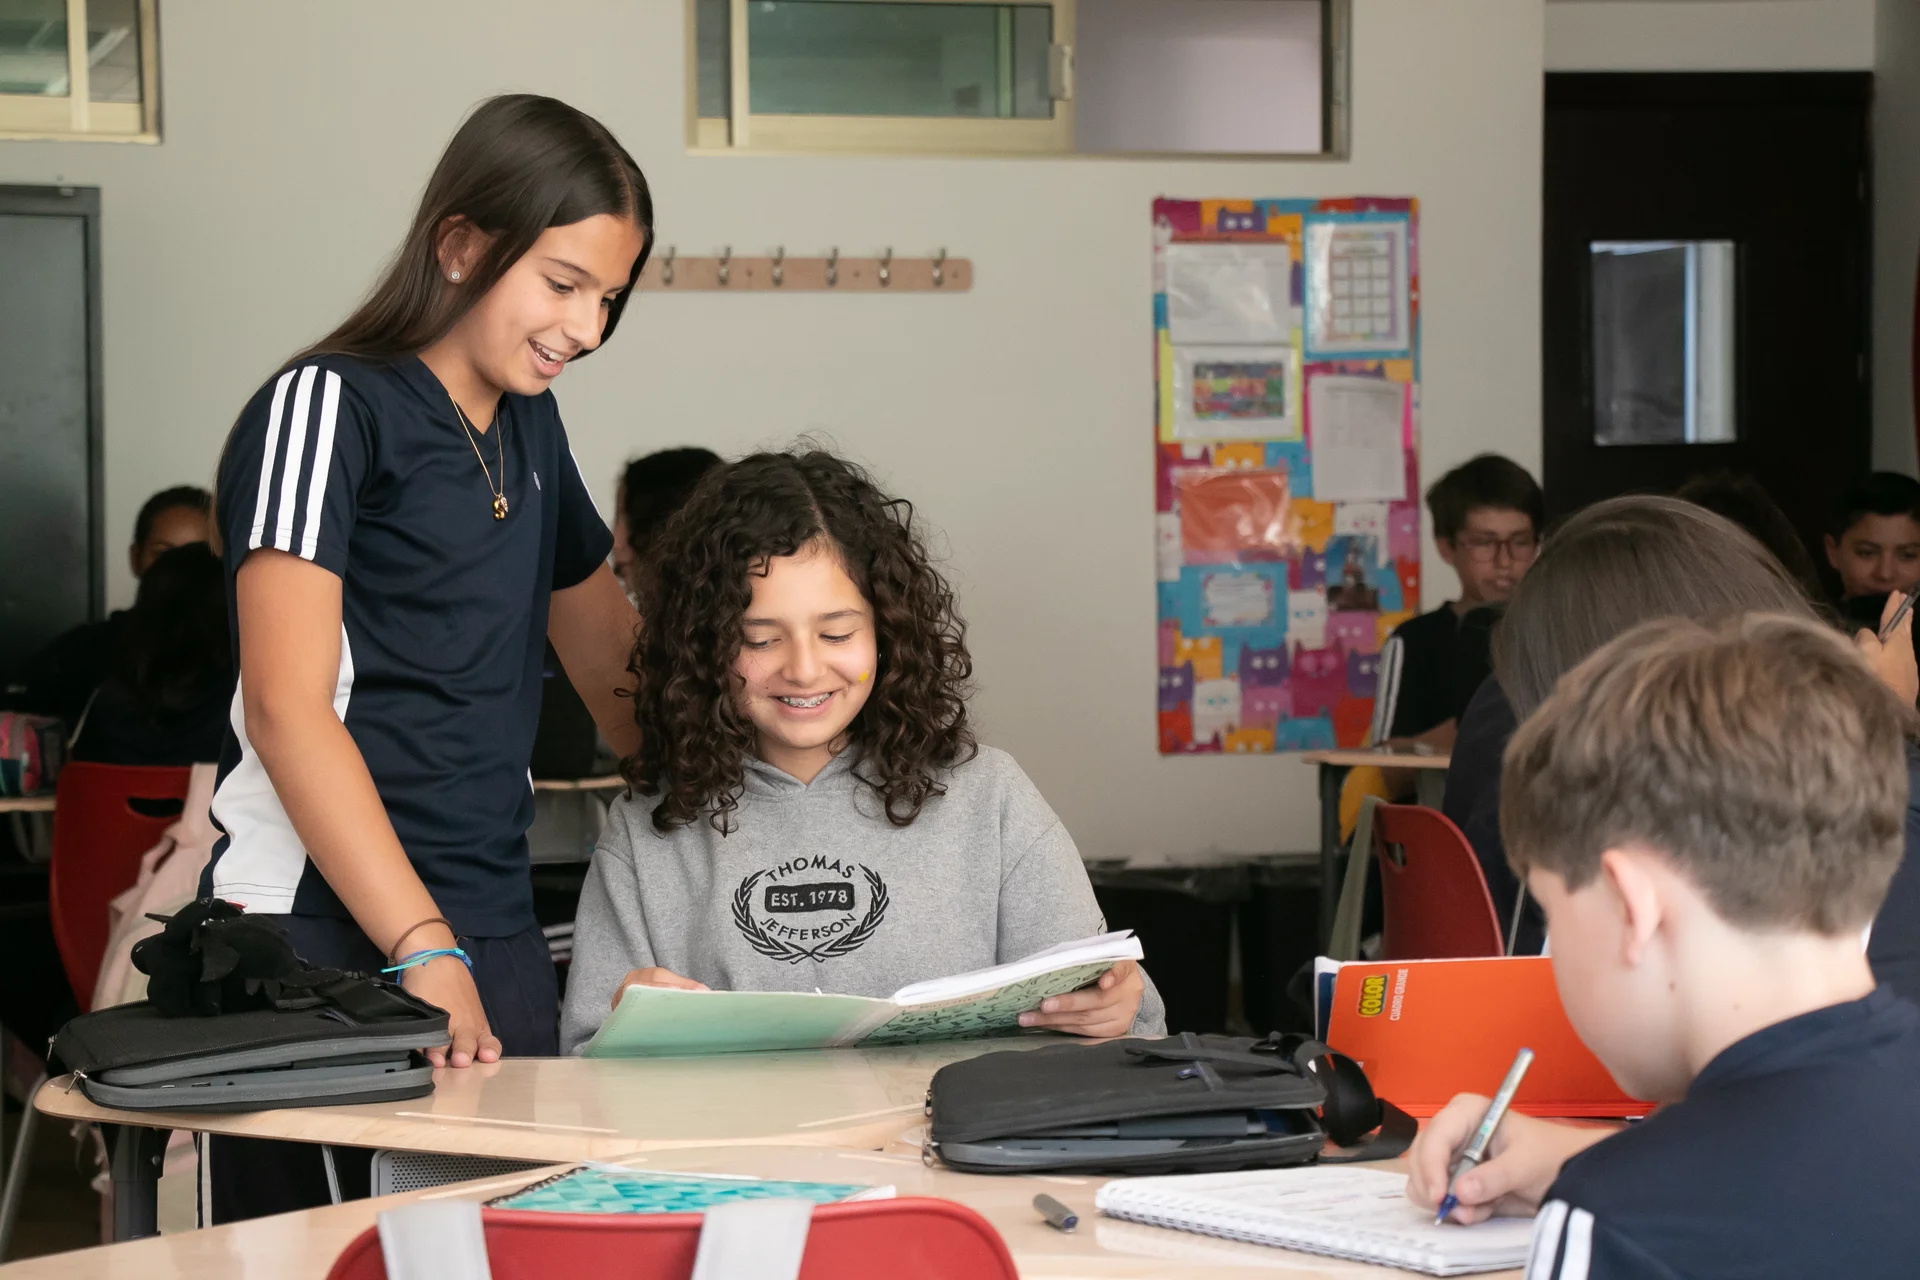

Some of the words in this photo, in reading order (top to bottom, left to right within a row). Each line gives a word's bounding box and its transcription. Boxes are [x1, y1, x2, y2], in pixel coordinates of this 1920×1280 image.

[765, 854, 855, 882] THOMAS
[771, 893, 804, 907] EST.
[809, 890, 848, 904] 1978
[760, 913, 857, 940] JEFFERSON
[1394, 968, 1409, 995] GRANDE
[1361, 977, 1385, 1015] COLOR
[1390, 995, 1404, 1021] CUADRO
